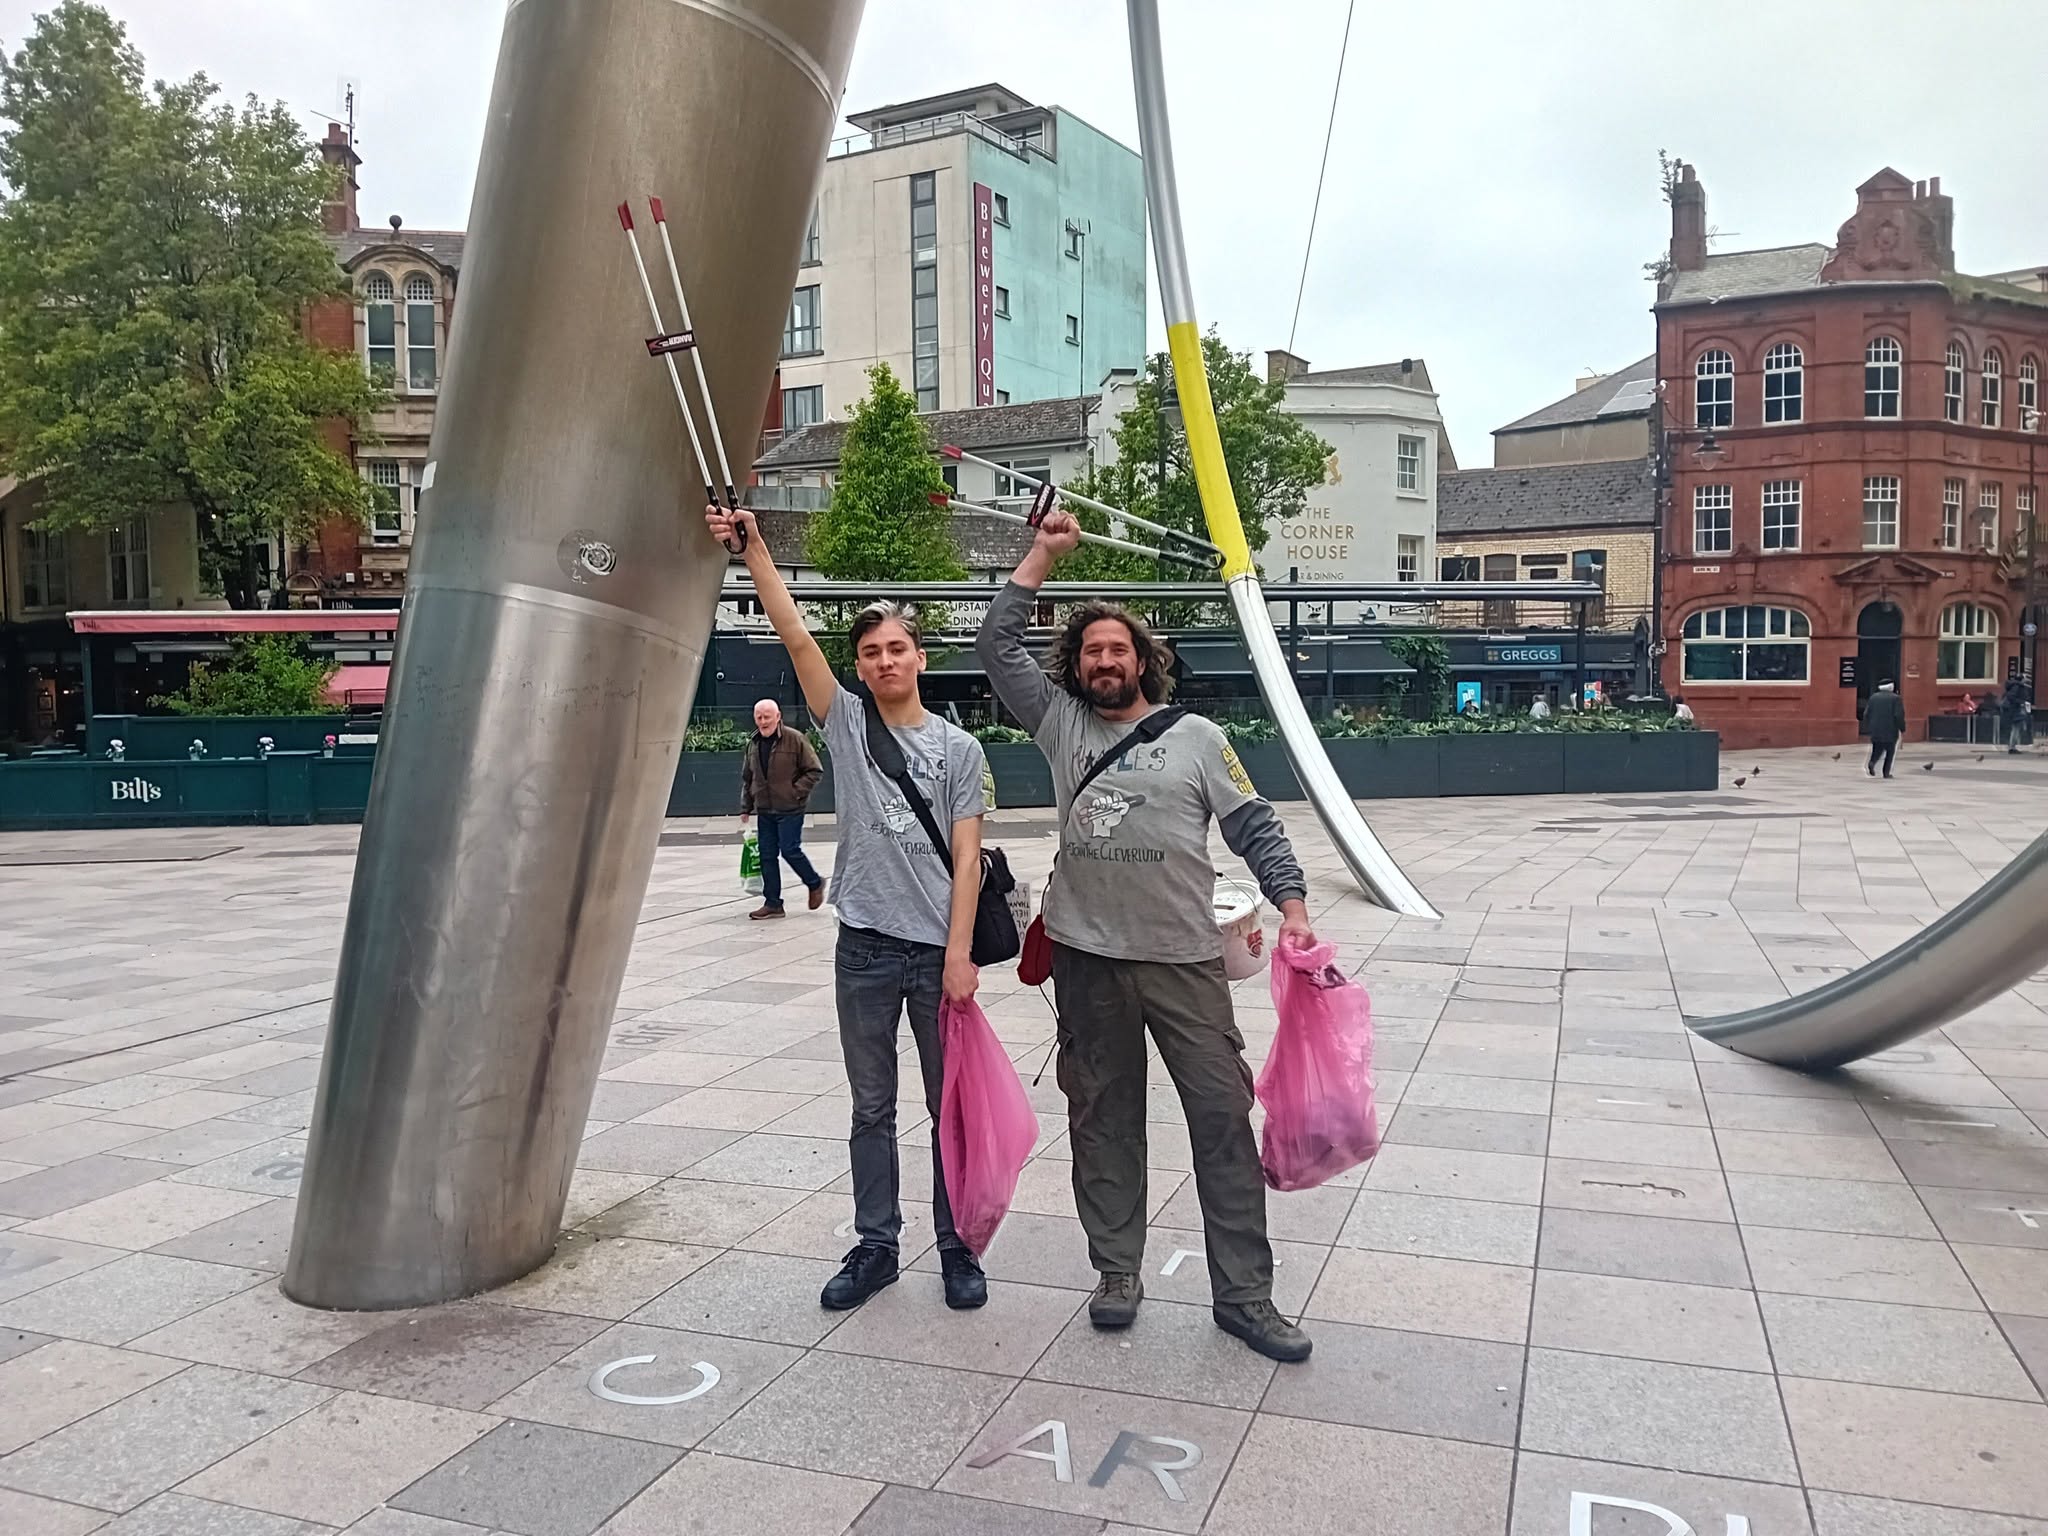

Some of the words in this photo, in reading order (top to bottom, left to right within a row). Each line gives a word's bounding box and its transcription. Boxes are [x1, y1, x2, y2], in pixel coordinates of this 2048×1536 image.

[980, 202, 990, 341] Brewery
[1306, 508, 1330, 519] THE
[1281, 525, 1354, 539] CORNER
[1288, 545, 1347, 559] HOUSE
[1314, 572, 1344, 580] DINING
[1501, 650, 1557, 661] GREGGS
[111, 777, 162, 803] Bill's
[587, 1354, 720, 1405] C
